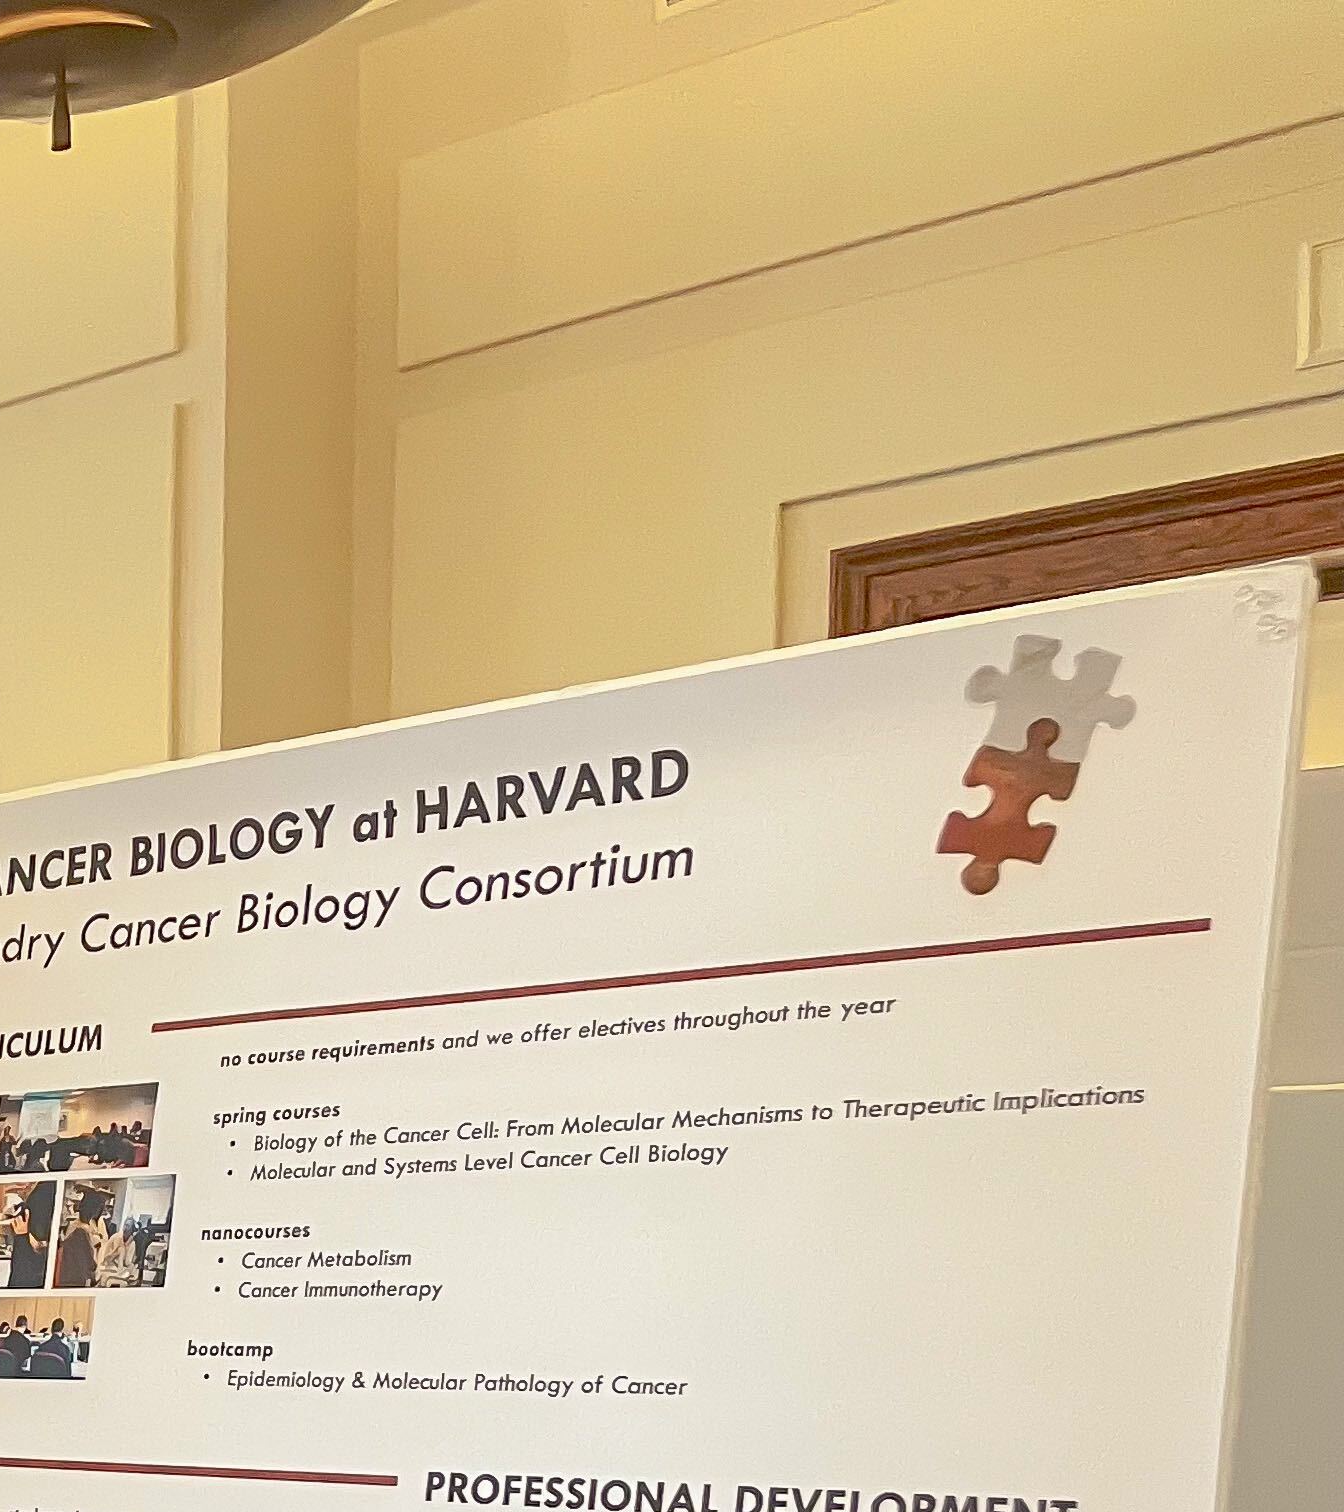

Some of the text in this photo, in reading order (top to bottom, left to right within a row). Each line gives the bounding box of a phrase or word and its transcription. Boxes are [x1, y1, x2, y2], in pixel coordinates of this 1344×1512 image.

[129, 803, 336, 878] BIOLOGY
[352, 799, 398, 843] at
[416, 749, 689, 834] HARVARD
[80, 909, 222, 953] Cancer
[237, 883, 401, 934] Biology
[419, 844, 694, 910] Consortium
[220, 998, 897, 1068] no course requirements and we offer electives throughout the year
[213, 1105, 341, 1129] spring courses
[254, 1085, 1145, 1154] Biology of the Cancer Cell: From Molecular Mechanisms to Therapeutic Implications
[249, 1142, 729, 1182] Molecular and Systems Level Cancer Cell Biology
[201, 1225, 311, 1241] nanocourses
[241, 1249, 412, 1269] Cancer Metabolism
[238, 1279, 443, 1302] Cancer Immunotherapy
[187, 1339, 274, 1362] bootcamp
[227, 1369, 689, 1398] Epidemiology & Molecular Pathology of Cancer
